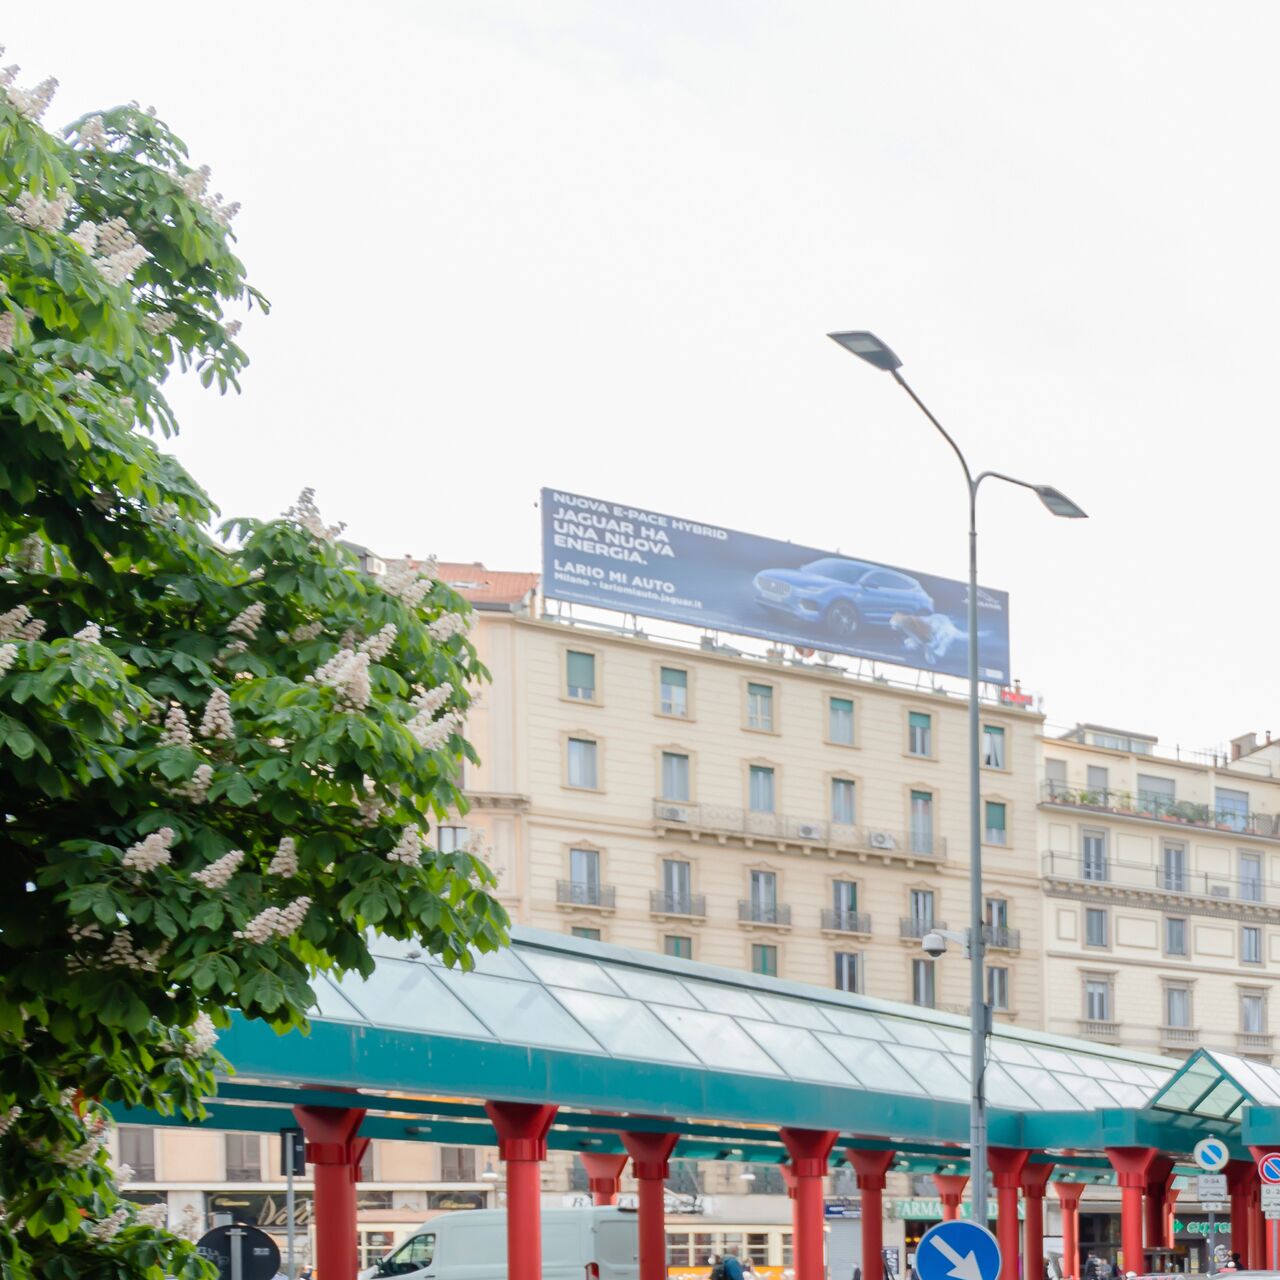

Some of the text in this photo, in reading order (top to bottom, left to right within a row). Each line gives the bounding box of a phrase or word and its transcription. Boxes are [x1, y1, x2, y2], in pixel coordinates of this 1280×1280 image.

[553, 492, 728, 541] NUOVA E-PACE HYBRID
[553, 507, 669, 543] JAGUAR HA
[553, 520, 675, 558] UNA NUOVA
[553, 534, 648, 565] ENERGIA.
[554, 559, 675, 594] LARIO MI AUTO
[554, 572, 591, 586] Milano
